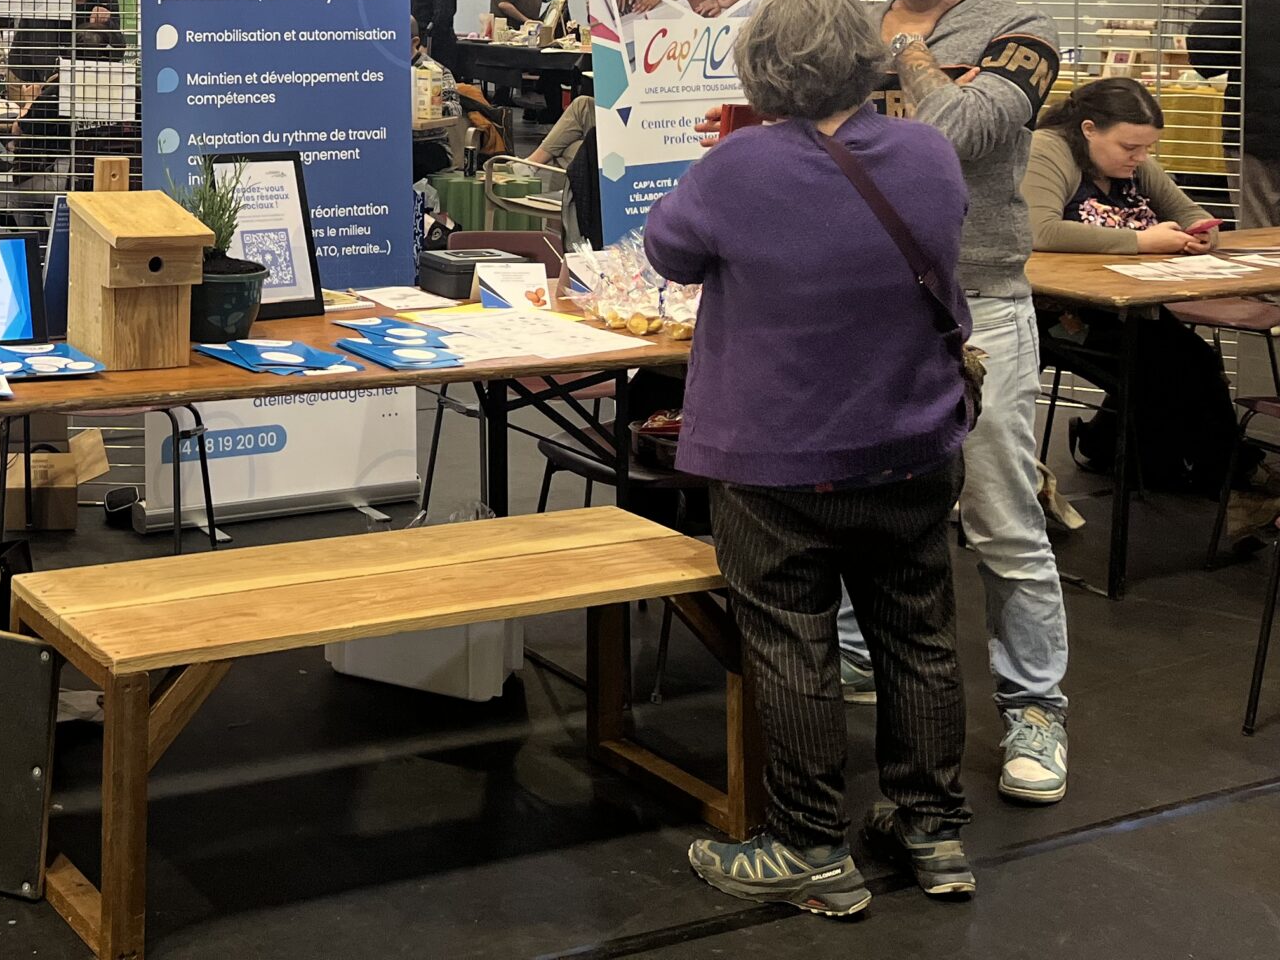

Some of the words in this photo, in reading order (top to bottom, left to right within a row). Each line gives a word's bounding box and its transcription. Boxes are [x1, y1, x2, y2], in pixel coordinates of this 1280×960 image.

[186, 30, 281, 43] Remobilisation
[283, 30, 296, 41] et
[299, 27, 396, 41] autonomisation
[186, 72, 243, 86] Maintien
[245, 73, 258, 84] et
[260, 70, 359, 86] développement
[362, 70, 384, 82] des
[682, 85, 701, 93] POUR
[702, 84, 718, 93] TOUS
[187, 92, 276, 108] compétences
[641, 117, 676, 130] Centre
[678, 115, 692, 128] de
[187, 131, 260, 149] Adaptation
[262, 131, 280, 144] du
[282, 130, 327, 146] rythme
[329, 128, 344, 141] de
[348, 127, 387, 140] travail
[256, 191, 289, 200] réseaux
[311, 202, 389, 218] réorientation
[327, 225, 337, 237] le
[338, 224, 371, 237] milieu
[315, 245, 340, 258] ATO,
[219, 436, 233, 451] 19
[236, 434, 254, 450] 20
[258, 432, 277, 447] 00
